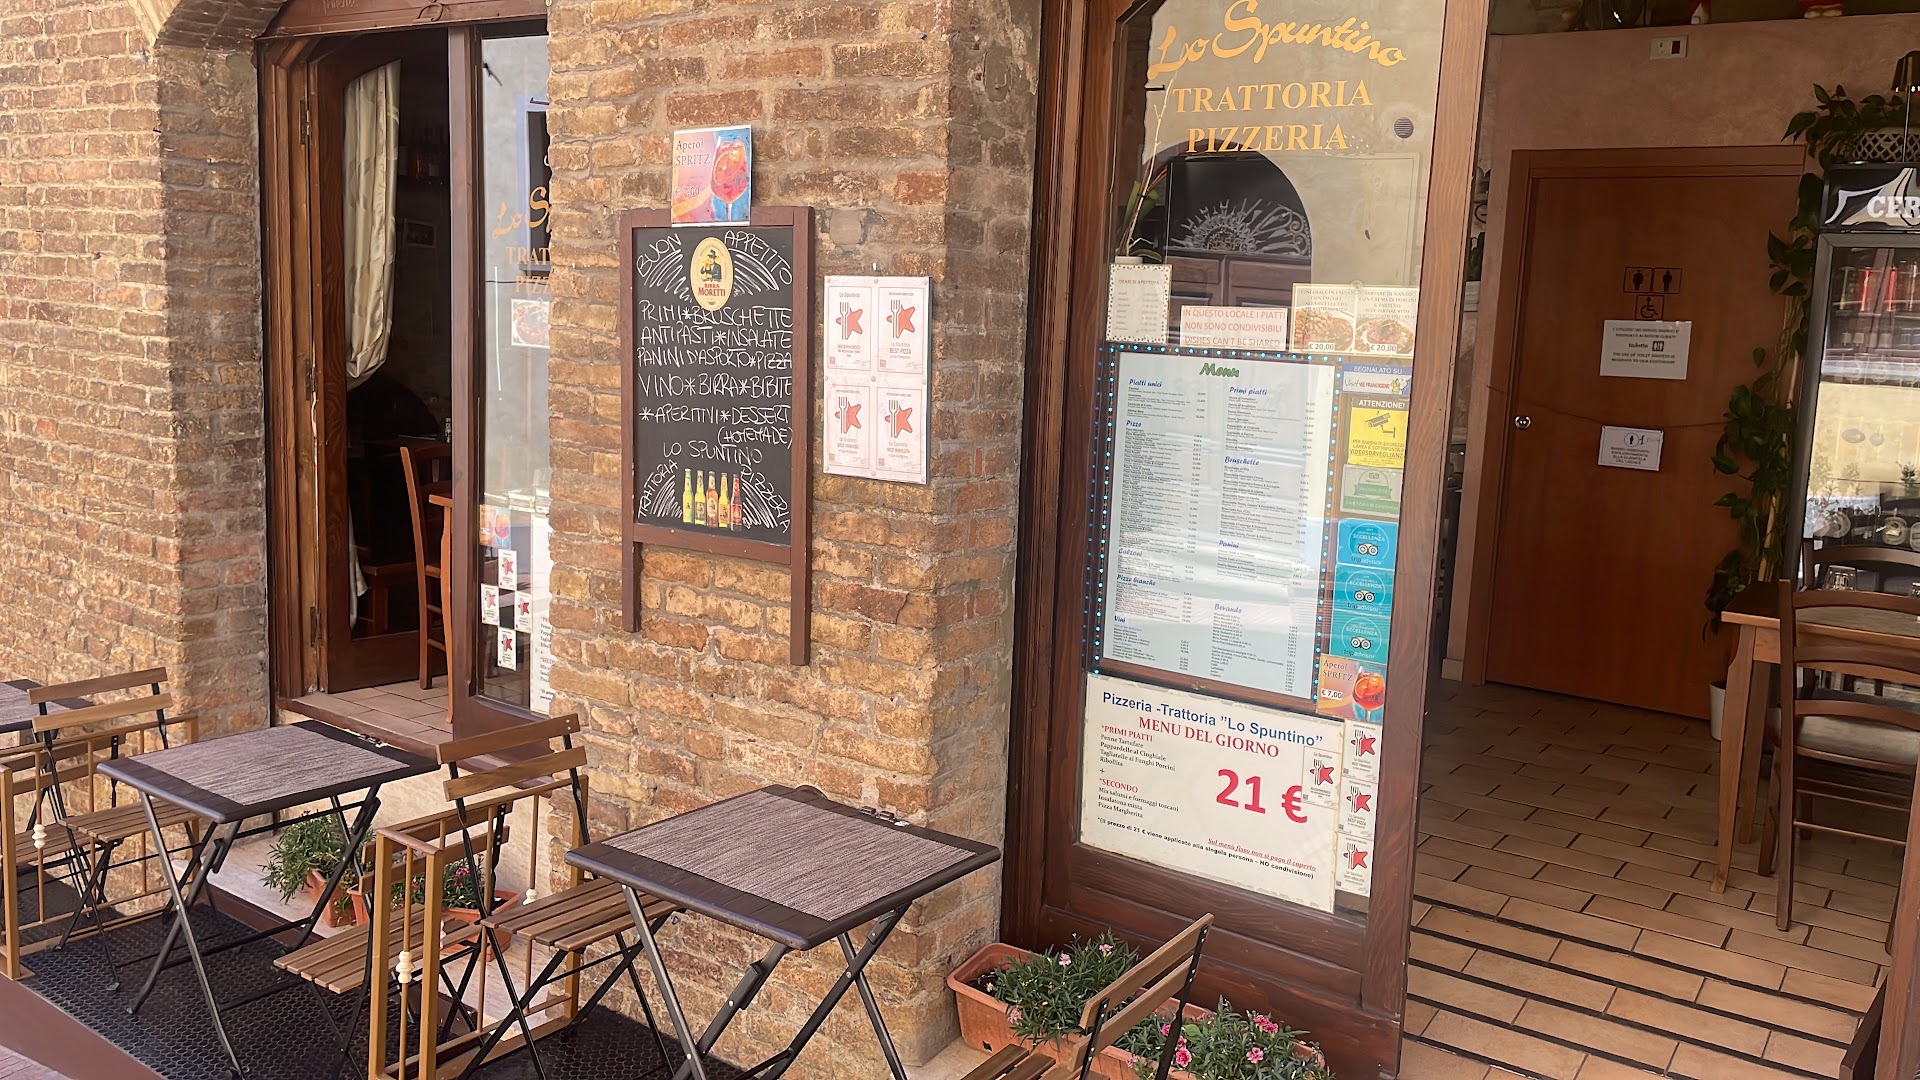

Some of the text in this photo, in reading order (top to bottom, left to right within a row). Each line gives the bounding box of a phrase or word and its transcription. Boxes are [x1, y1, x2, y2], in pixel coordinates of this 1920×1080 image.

[1147, 0, 1407, 81] Lo Spuntino
[1173, 79, 1373, 114] TRATTORIA
[676, 138, 704, 152] Aperol
[1186, 123, 1350, 154] PIZZERIA
[676, 154, 711, 166] SPRITZ
[636, 230, 793, 285] BUON APPETITO
[697, 286, 726, 297] MORETTI
[639, 299, 682, 322] PRIMI
[1192, 309, 1224, 318] QUESTO
[1225, 310, 1256, 318] LOCALE
[1260, 311, 1286, 320] PIATTI
[640, 320, 793, 349] ANTIPASTI INSALATE
[1184, 322, 1282, 333] NON SONO CONDIVISIBILI
[1184, 336, 1280, 348] DISHES CAN'T BE SHARED
[1315, 343, 1335, 351] 20,00
[1376, 344, 1397, 352] 20,00
[637, 346, 685, 368] PANINI
[755, 350, 793, 370] PIZZA
[1198, 362, 1240, 378] Menu
[1353, 365, 1392, 374] SEGNALATO
[638, 372, 793, 399] VINO BIRRA BIBITE
[1228, 386, 1268, 397] Primi piatti
[1358, 399, 1406, 410] ATTENZIONE!
[732, 404, 792, 425] DESSERT
[663, 440, 763, 465] LO SPUNTINO
[637, 458, 679, 519] TRATTORIA
[740, 463, 791, 534] PIZZERIA
[1218, 539, 1240, 549] Panini
[1351, 555, 1384, 565] tripadvisor
[1133, 575, 1157, 586] bianche
[1347, 601, 1379, 612] tripadvisor
[1343, 649, 1376, 660] tripadvisor
[1323, 659, 1348, 671] Aperol
[1322, 669, 1354, 682] SPRITZ
[1327, 690, 1342, 699] 7,00
[1103, 691, 1153, 713] Pizzeria
[1156, 703, 1217, 726] -Trattoria
[1100, 734, 1118, 743] Penne
[1128, 730, 1154, 742] PIATTI
[1138, 716, 1280, 758] MENU DEL GIORNO
[1100, 742, 1133, 754] Pappardelle
[1140, 750, 1167, 762] Cinghiale
[1099, 757, 1124, 767] Ribollita
[1100, 750, 1128, 761] Tagliatelle
[1135, 756, 1155, 768] Funghi
[1155, 761, 1176, 772] Porcini
[1099, 787, 1109, 795] Mix
[1109, 789, 1128, 799] salumi
[1132, 794, 1158, 807] formaggi
[1158, 802, 1179, 812] toscani
[1215, 768, 1308, 825] 21 €
[1098, 801, 1144, 818] Pizza Margherita
[1107, 819, 1126, 829] prezzo
[1204, 845, 1228, 857] singola
[1228, 851, 1254, 864] persona
[1259, 858, 1270, 868] NO
[1270, 863, 1315, 880] condivisione)
[1207, 837, 1219, 847] Sul
[1251, 848, 1263, 858] non
[1269, 852, 1286, 866] paga
[1292, 859, 1317, 873] coperto
